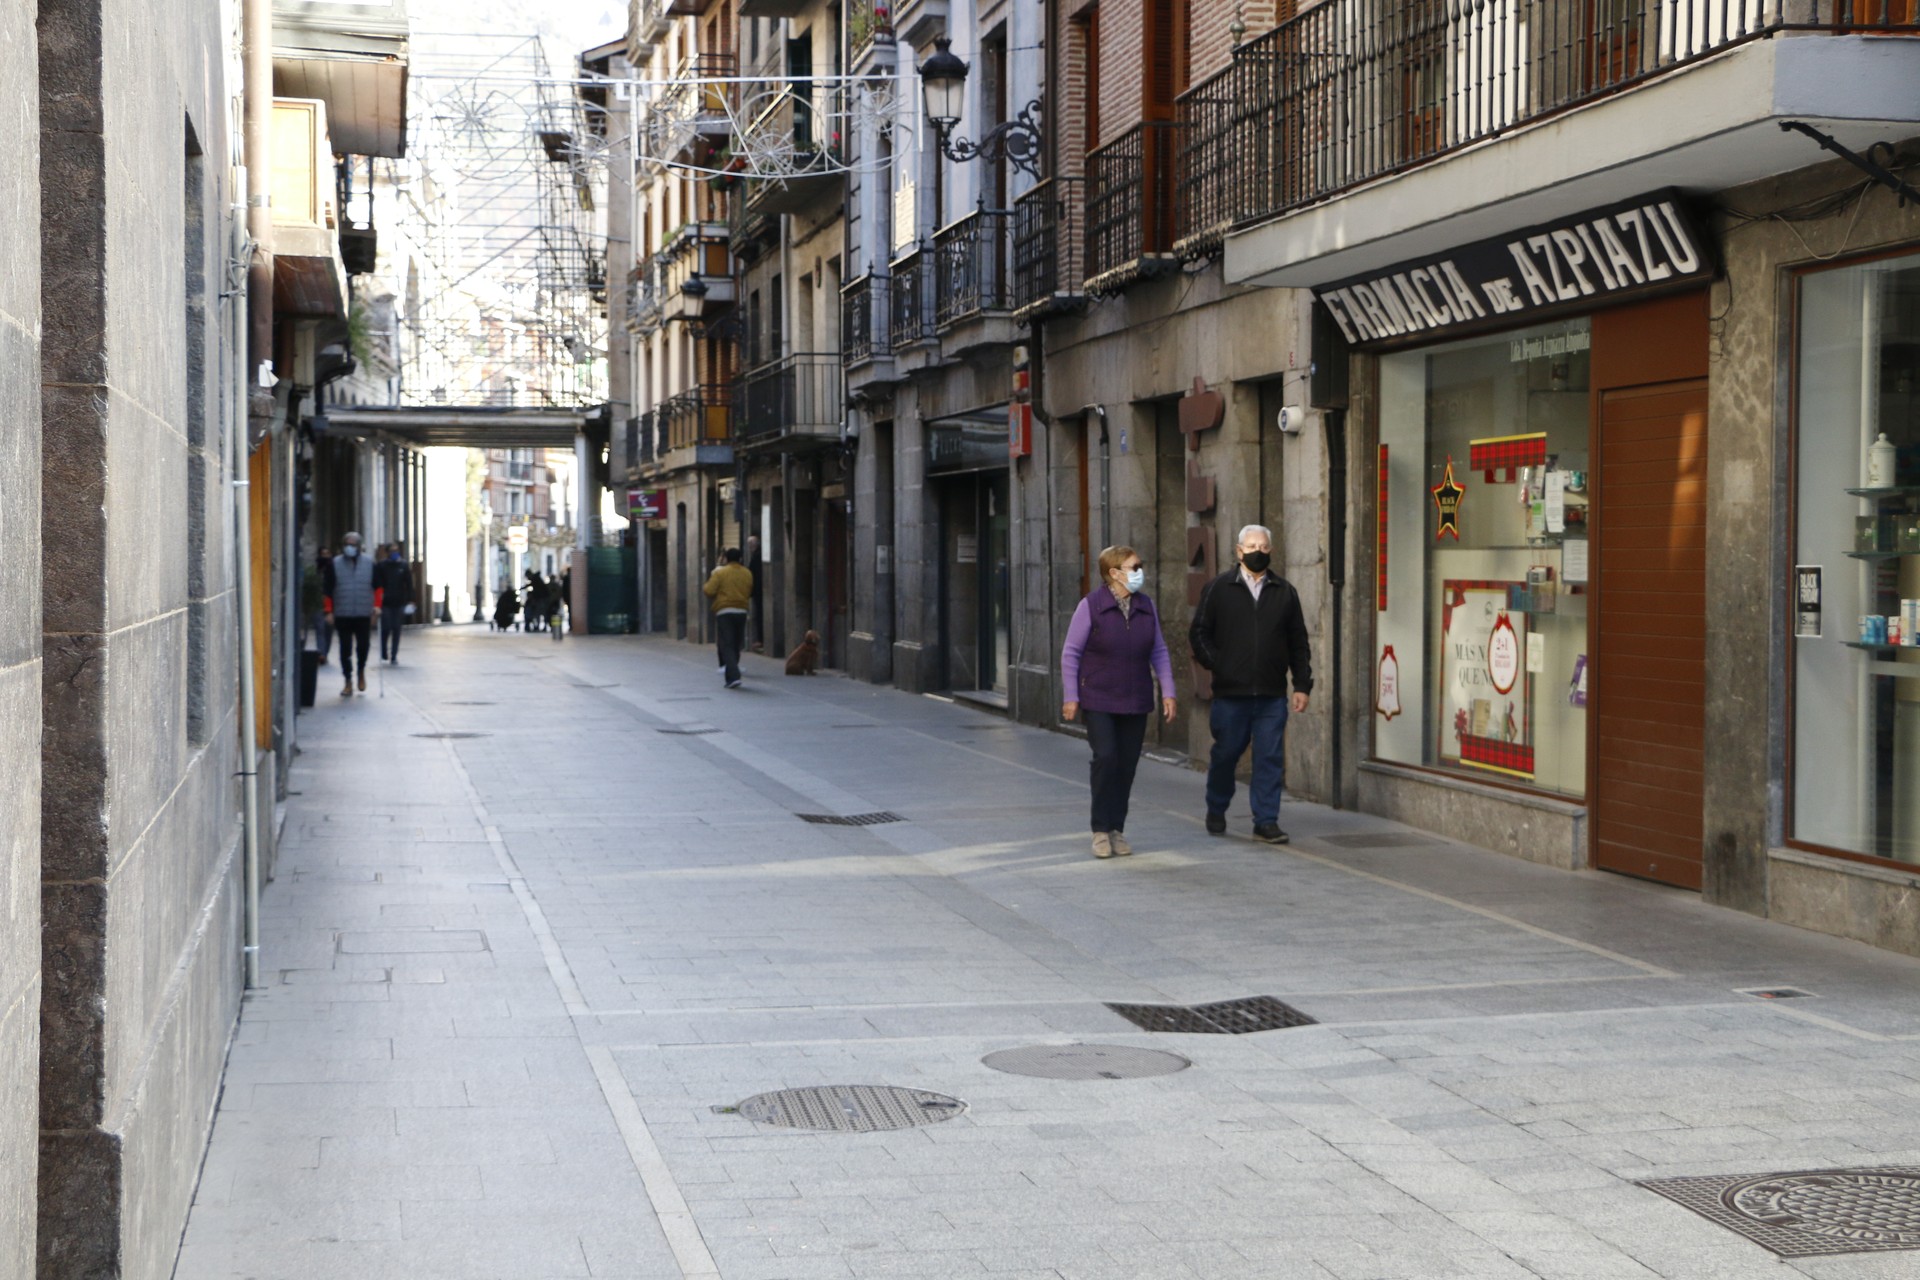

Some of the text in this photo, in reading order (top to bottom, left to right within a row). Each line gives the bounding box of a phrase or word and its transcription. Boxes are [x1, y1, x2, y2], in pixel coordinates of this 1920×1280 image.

[1320, 201, 1700, 344] FARMACIA DE AZPIAZU
[1800, 573, 1817, 588] BLACK
[1800, 588, 1819, 603] FRIDAY
[1456, 638, 1475, 661] MÁS
[1459, 667, 1480, 688] QUE
